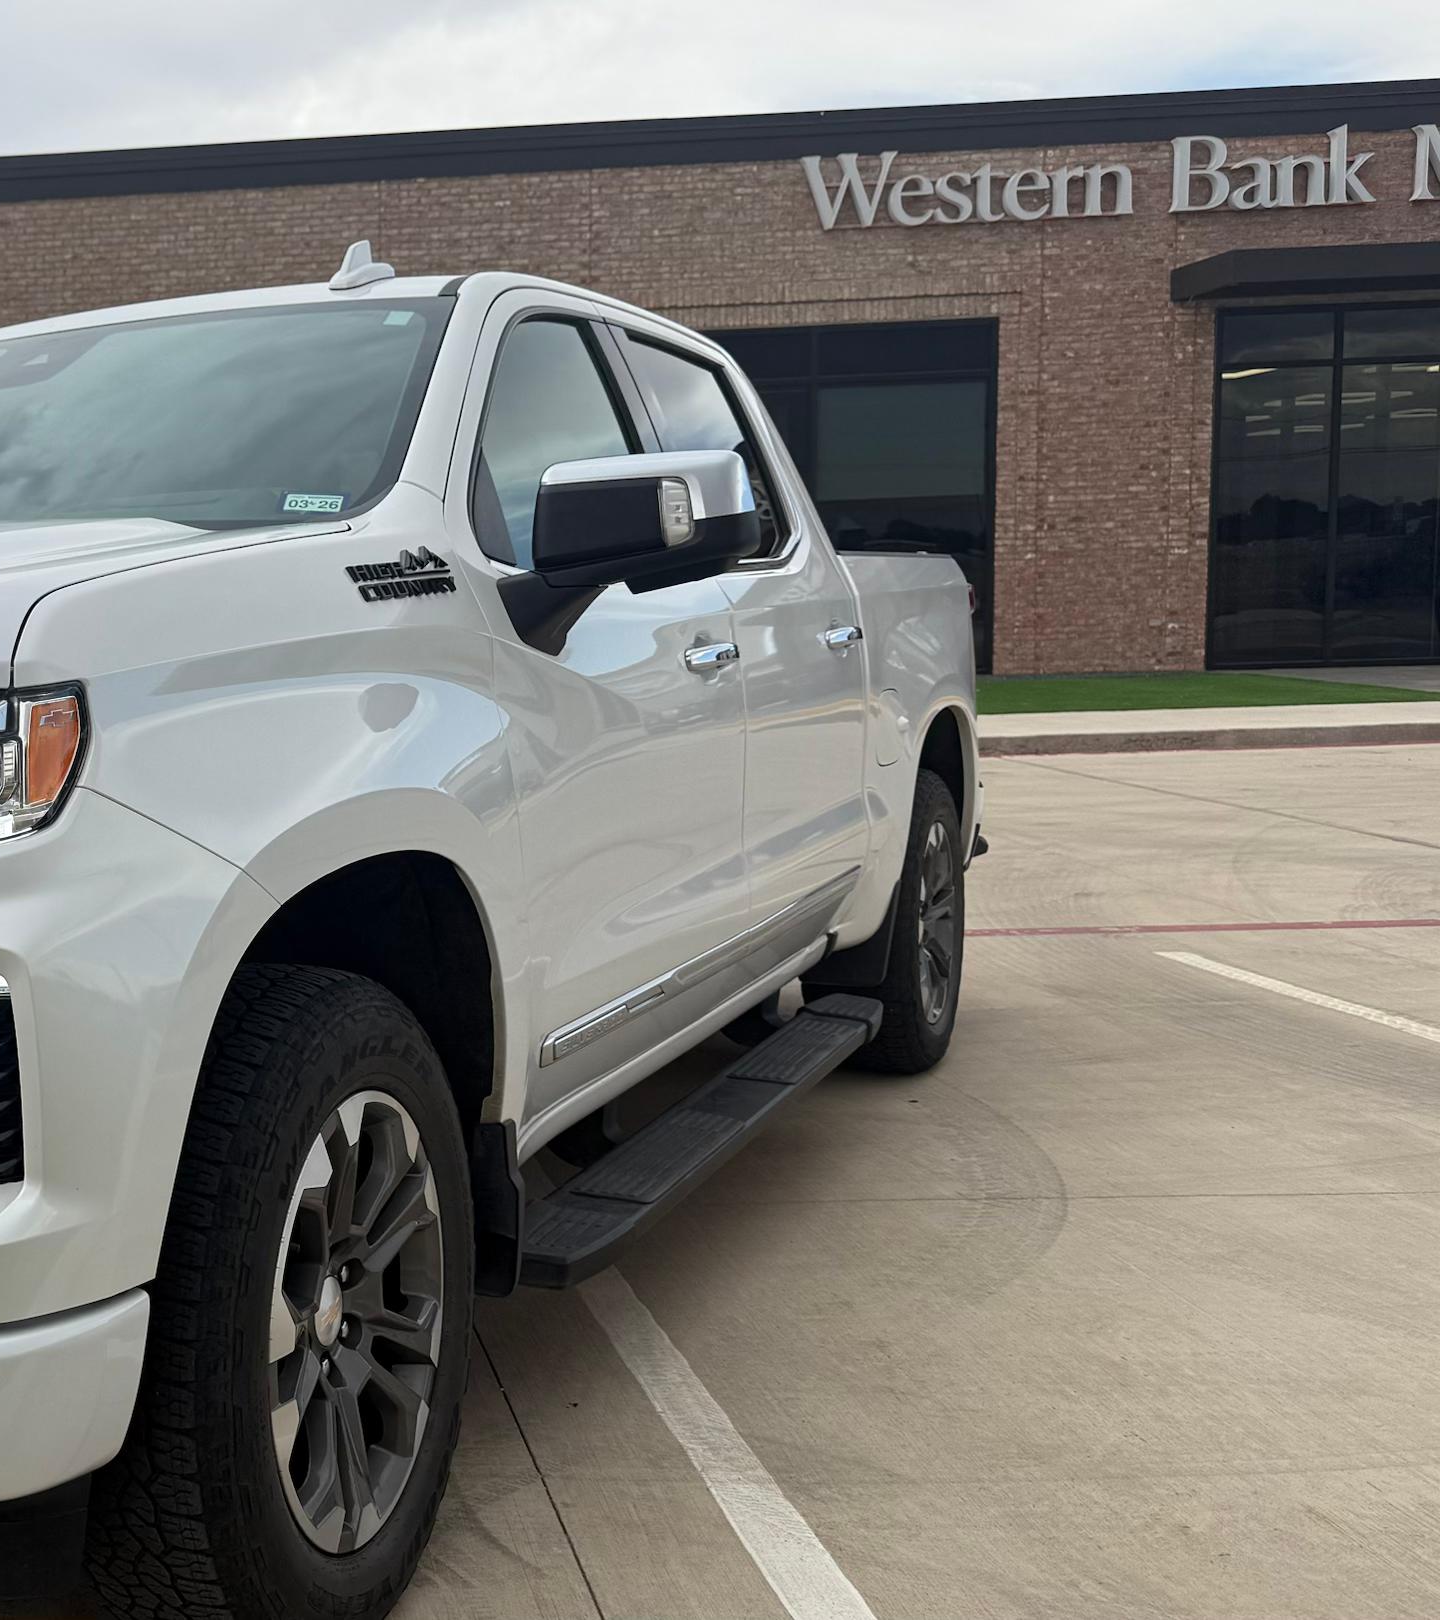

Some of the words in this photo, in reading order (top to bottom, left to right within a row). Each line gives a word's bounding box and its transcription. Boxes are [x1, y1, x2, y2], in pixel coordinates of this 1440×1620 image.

[800, 151, 1133, 230] Western
[1169, 124, 1377, 213] Bank
[288, 499, 309, 509] 03
[317, 500, 339, 510] 26
